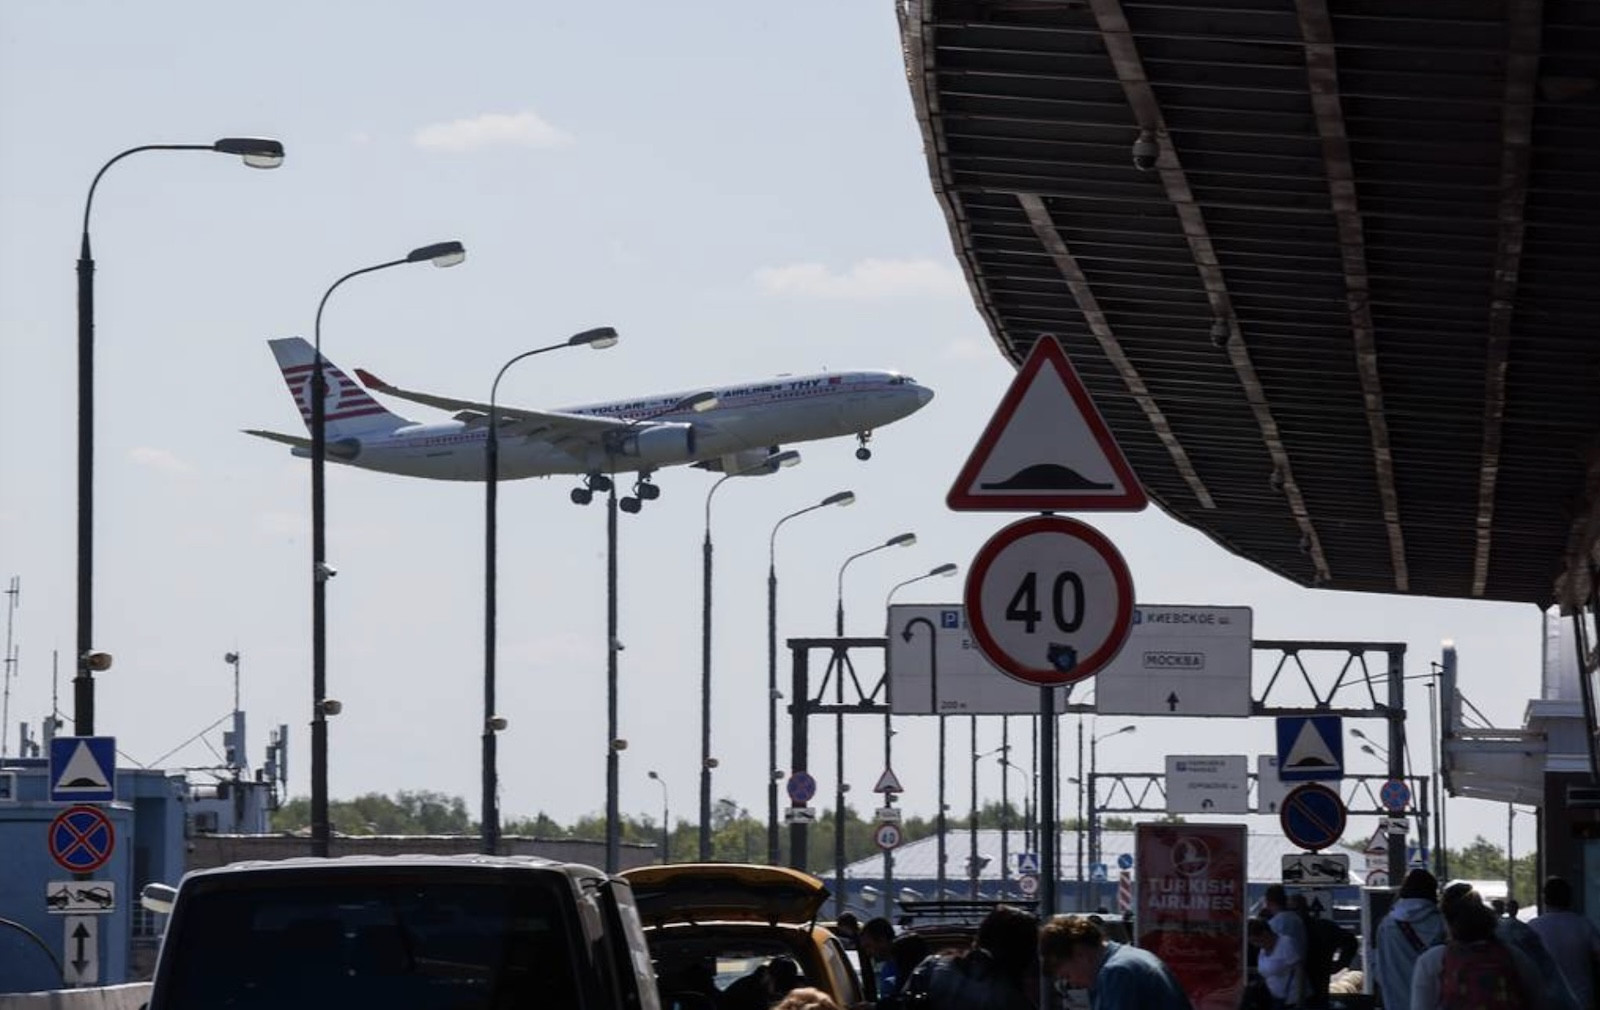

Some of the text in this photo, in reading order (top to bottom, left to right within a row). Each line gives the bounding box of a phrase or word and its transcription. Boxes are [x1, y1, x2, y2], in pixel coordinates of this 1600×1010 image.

[723, 385, 782, 398] AIRLINES
[789, 379, 821, 391] THY
[1006, 571, 1085, 633] 40
[1147, 612, 1215, 625] КИЕВСКОЕ
[1146, 654, 1200, 667] МОСКВА
[882, 831, 895, 844] 40
[1149, 878, 1234, 894] TURKISH
[1148, 894, 1234, 910] AIRLINES
